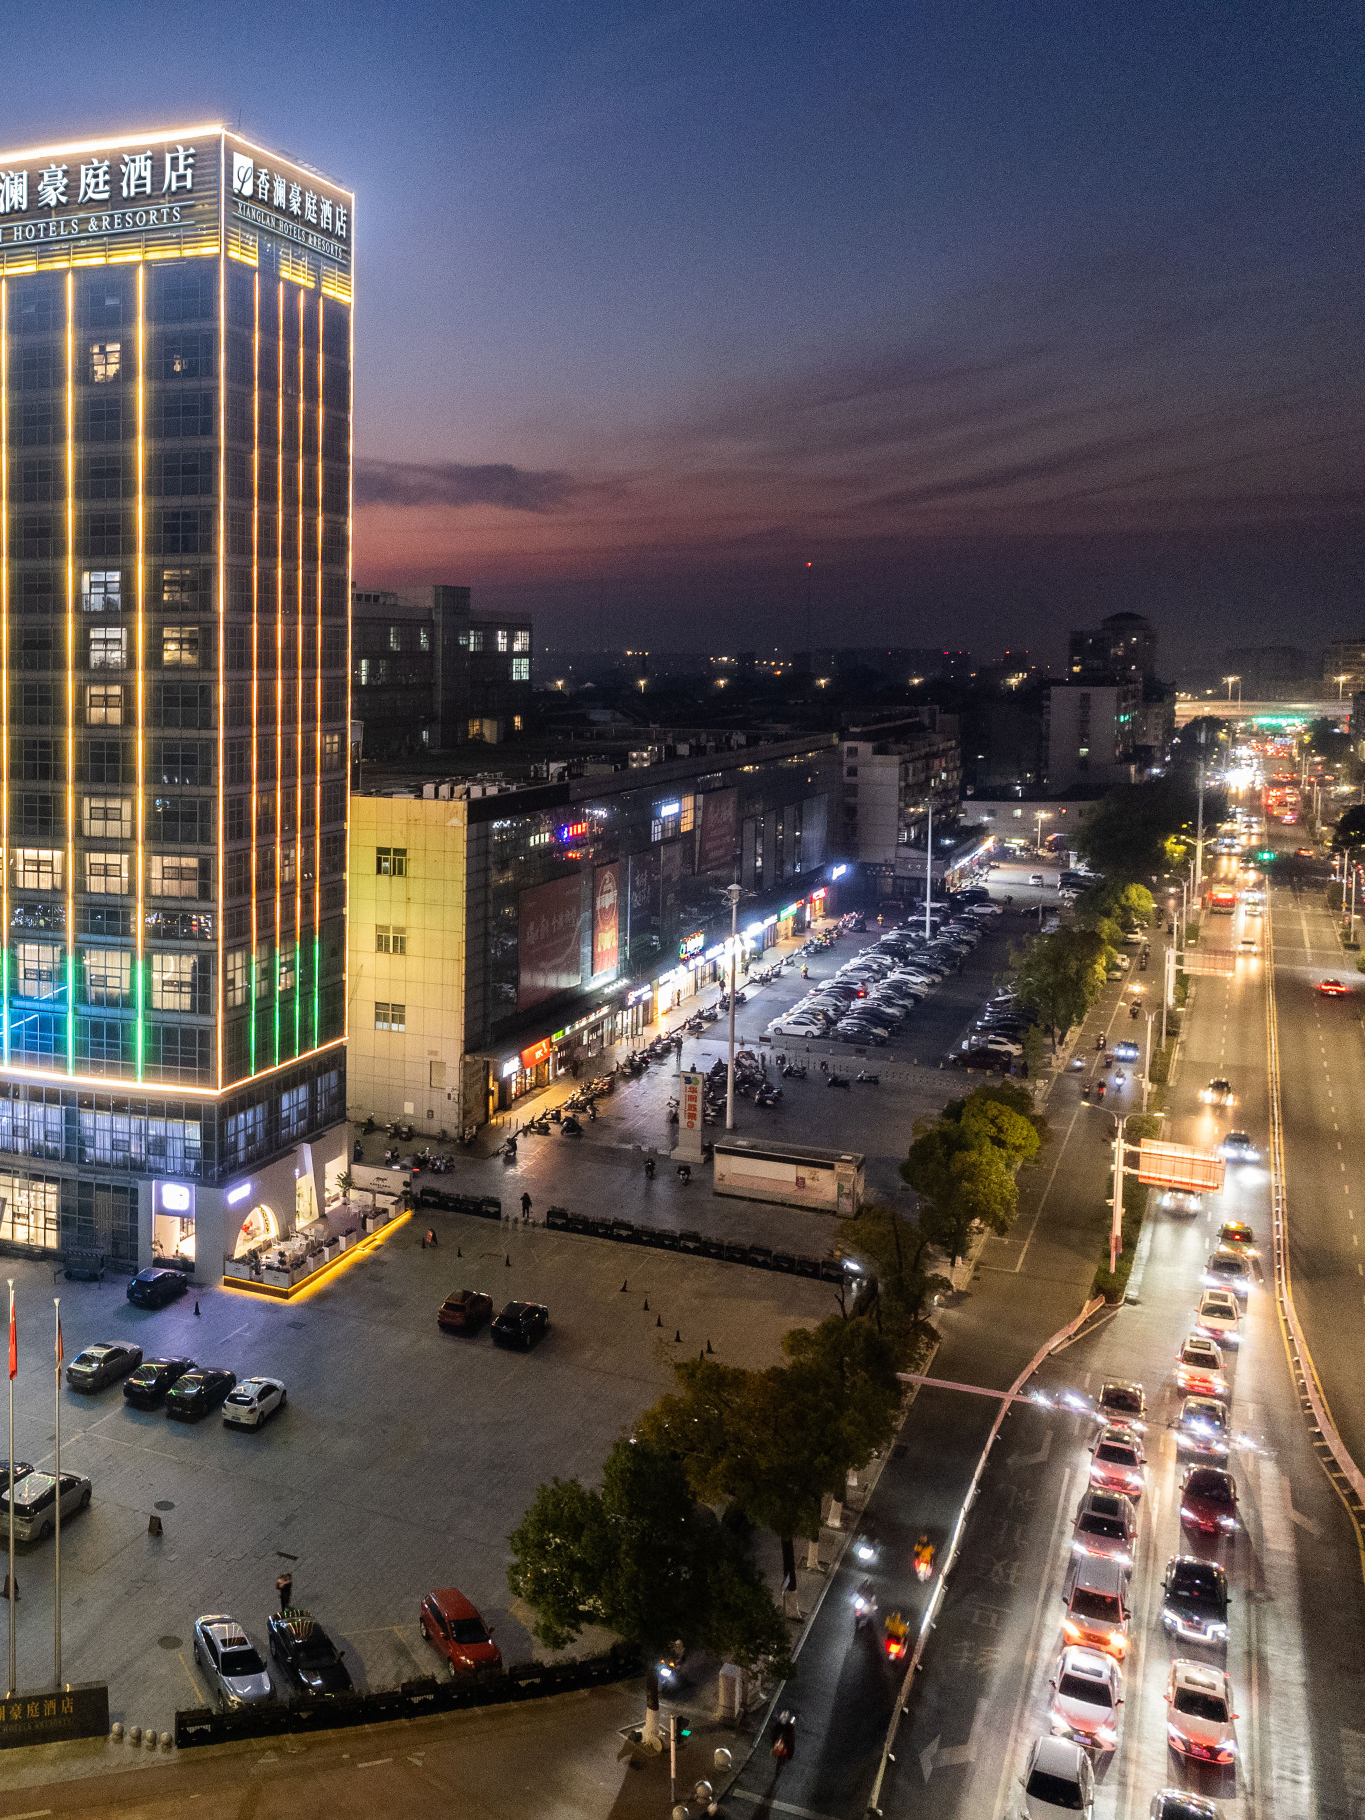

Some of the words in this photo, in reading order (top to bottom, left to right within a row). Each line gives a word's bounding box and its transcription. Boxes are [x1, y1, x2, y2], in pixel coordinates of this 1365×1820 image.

[13, 219, 80, 242] HOTELS
[88, 207, 182, 233] &RESORTS
[237, 202, 276, 230] XIANGLAN
[279, 220, 306, 243] HOTELS
[256, 168, 348, 240] 香澜豪庭酒店
